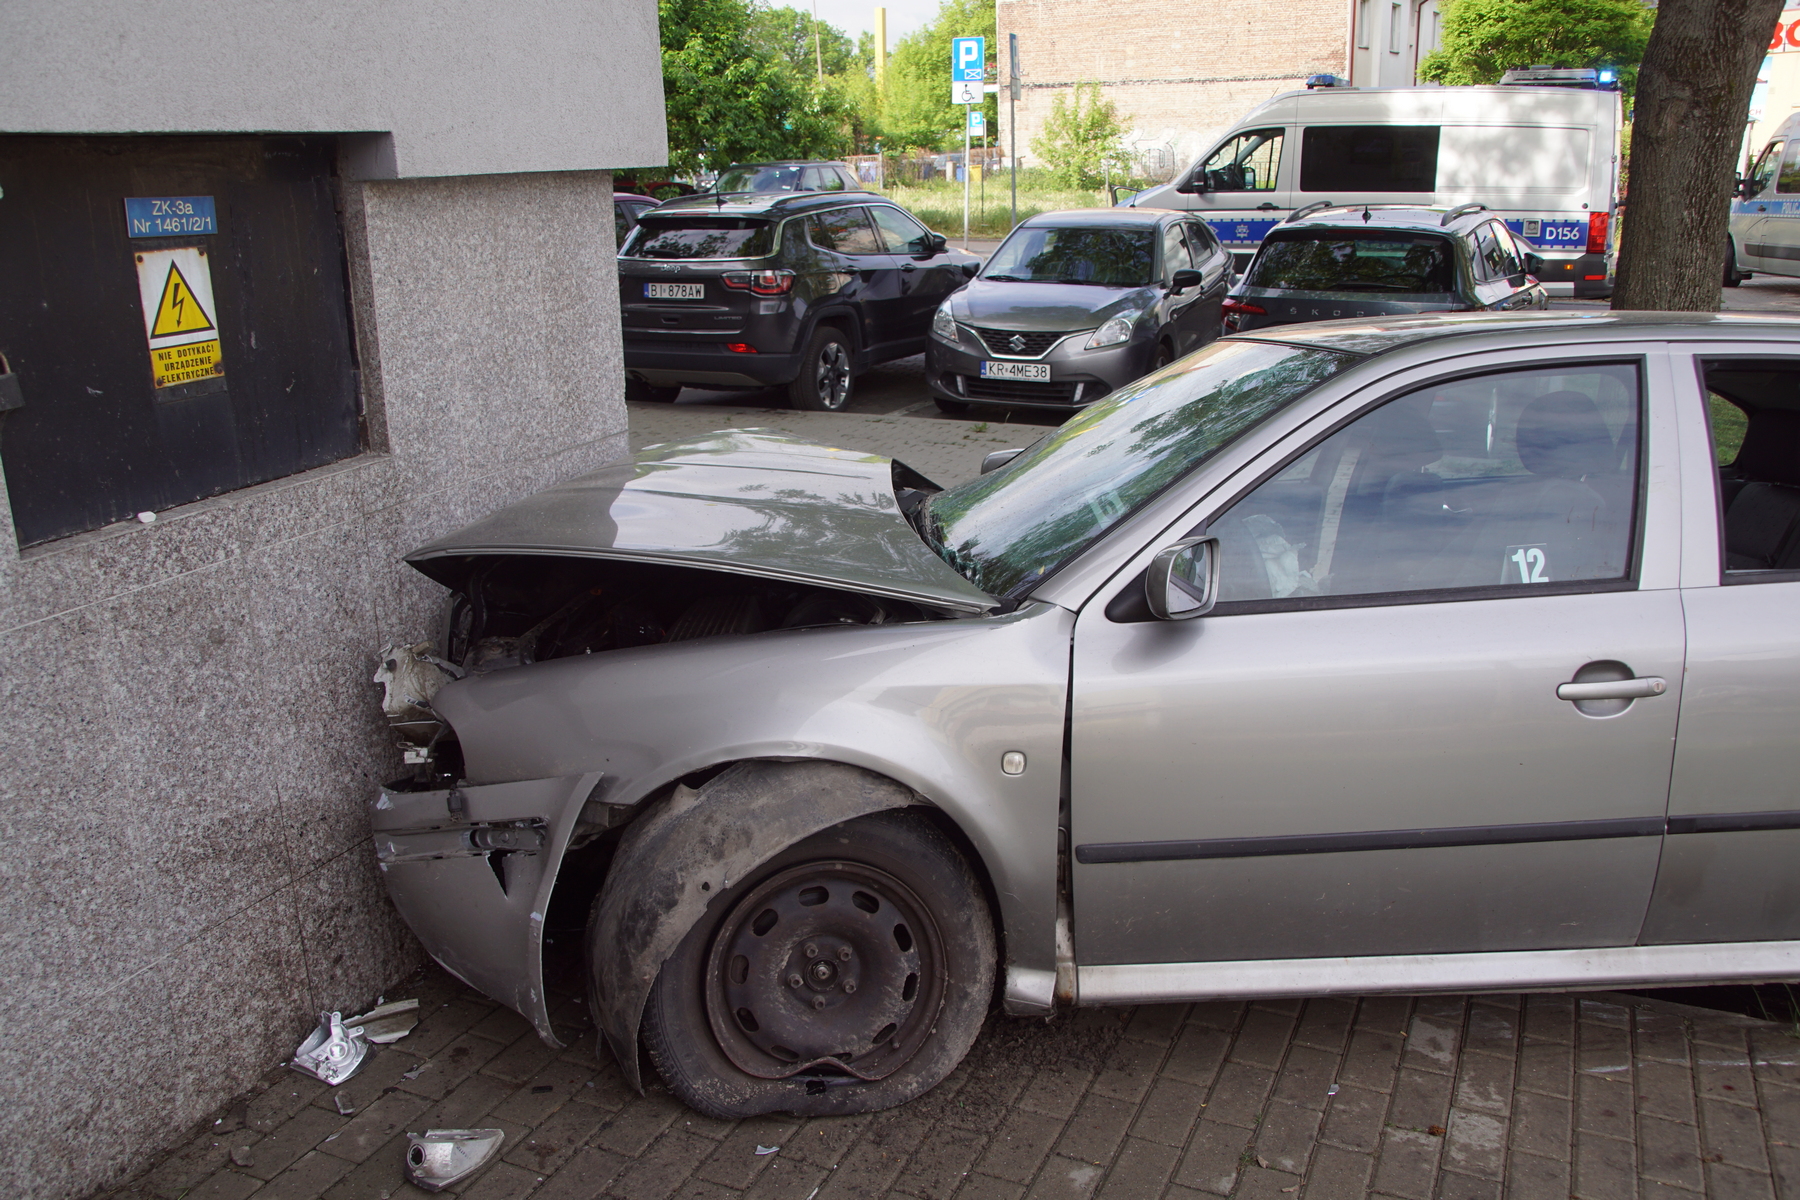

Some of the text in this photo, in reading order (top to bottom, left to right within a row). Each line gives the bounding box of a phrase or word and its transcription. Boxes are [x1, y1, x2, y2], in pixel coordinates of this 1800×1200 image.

[959, 40, 978, 69] P
[151, 200, 195, 216] ZK-3a
[133, 216, 213, 234] Nr 1461/2/1
[1545, 226, 1580, 240] D156
[650, 284, 702, 298] BI 878AW
[158, 343, 215, 362] NIE DOTYKAĆ!
[164, 355, 212, 371] URZĄDZENIE
[988, 362, 1005, 376] KR
[1009, 364, 1048, 379] 4ME38
[161, 366, 215, 384] ELEKTRYCZNE
[1511, 547, 1550, 584] 12
